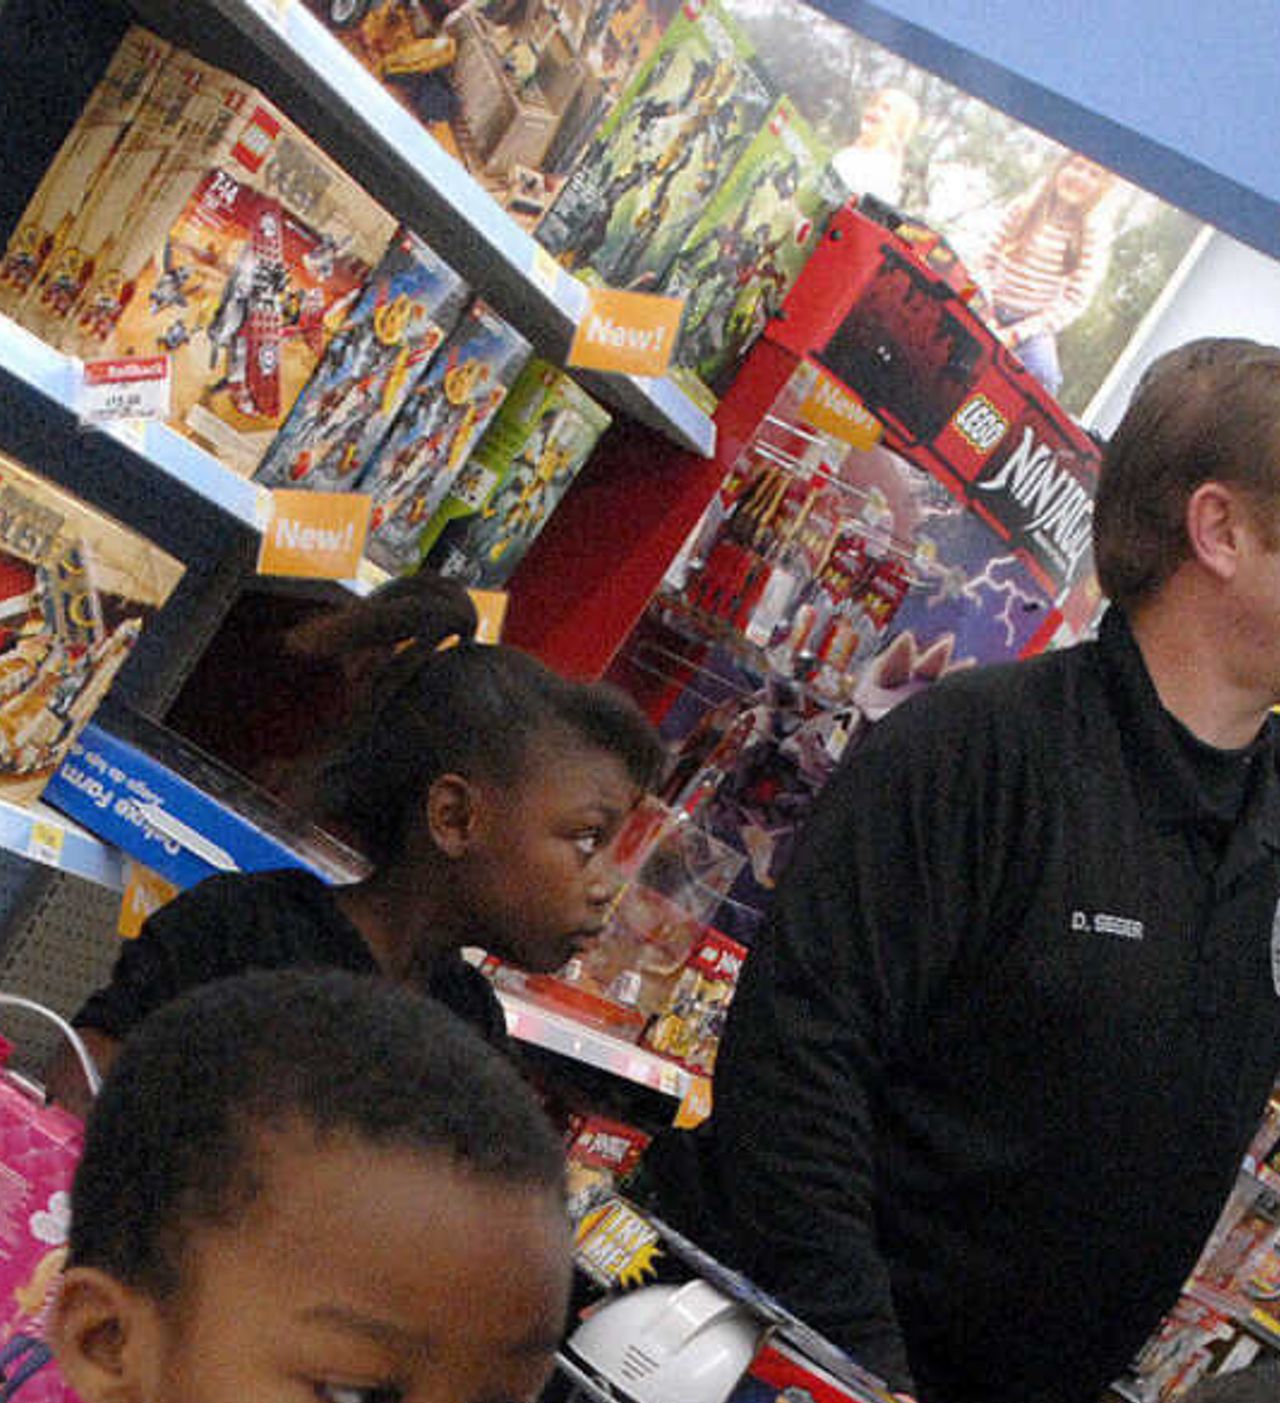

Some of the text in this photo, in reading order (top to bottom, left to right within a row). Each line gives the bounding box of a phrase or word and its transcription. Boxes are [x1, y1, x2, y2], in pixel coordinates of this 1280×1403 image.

[585, 312, 666, 351] New!
[956, 398, 1008, 452] LEGO
[275, 509, 355, 555] New!
[59, 761, 116, 812] Farm
[1071, 911, 1091, 932] D.
